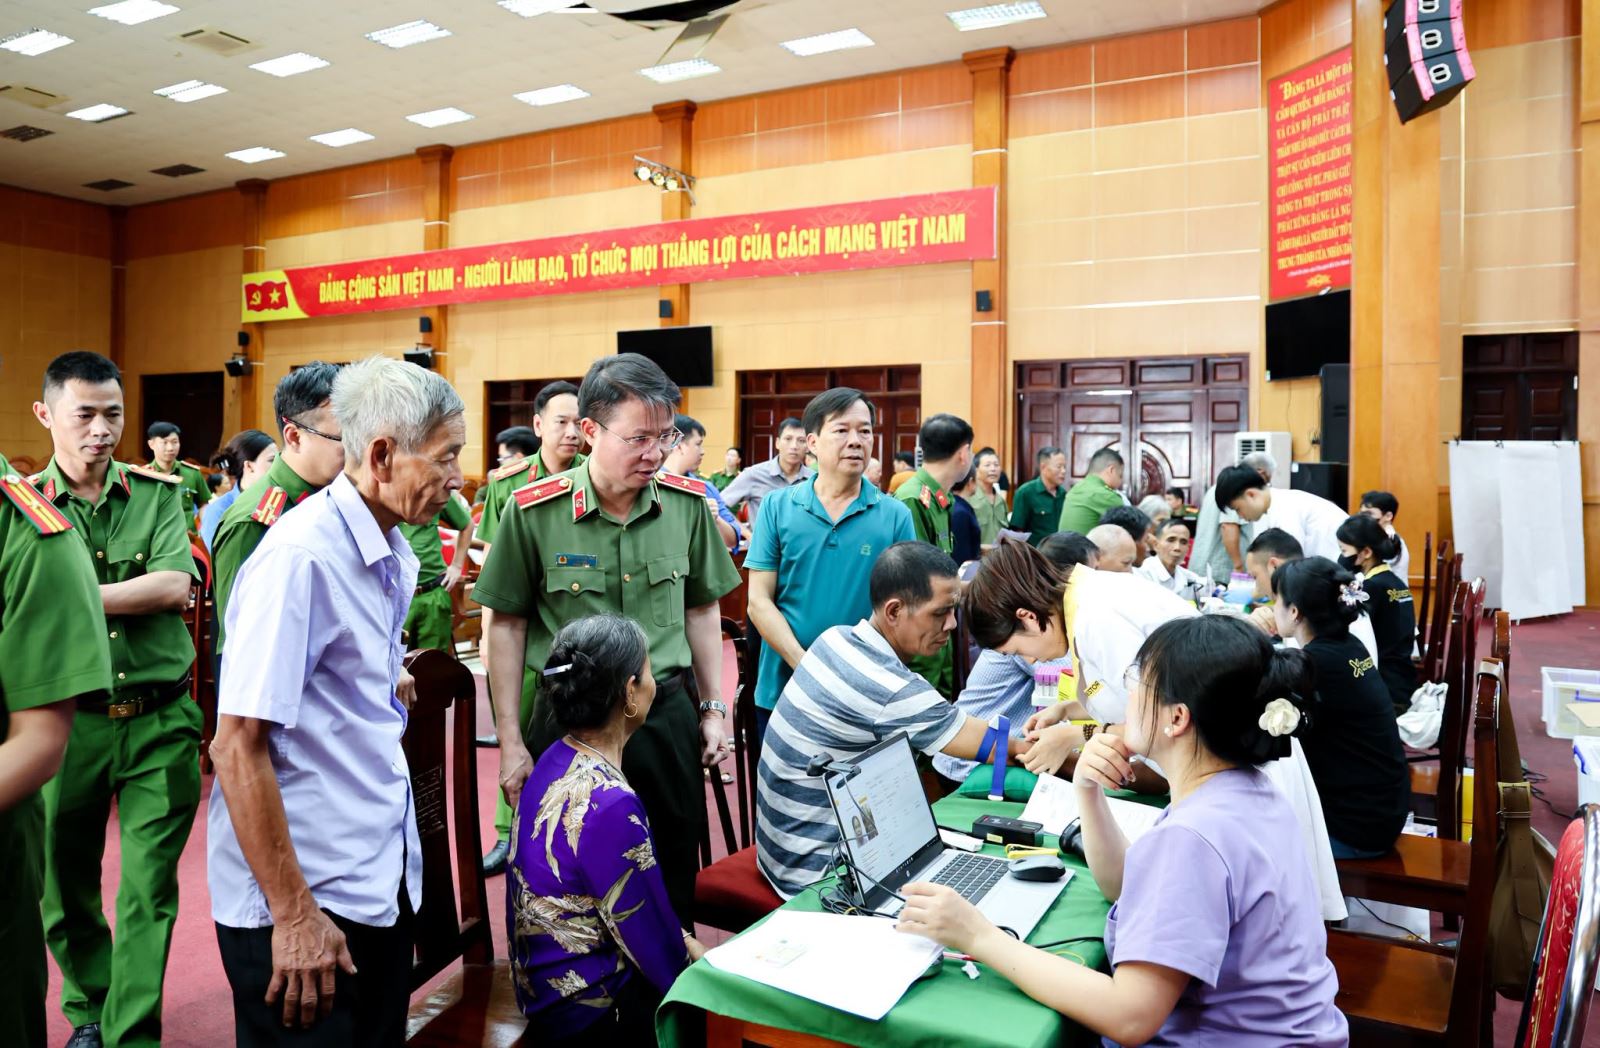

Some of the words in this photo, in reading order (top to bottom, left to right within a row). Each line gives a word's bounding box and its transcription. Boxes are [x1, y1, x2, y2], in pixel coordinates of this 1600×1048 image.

[320, 273, 346, 303] ĐẢNG
[348, 274, 376, 304] CỘNG
[378, 266, 400, 297] SẢN
[403, 268, 425, 297] VIỆT
[428, 267, 454, 292] NAM
[464, 258, 500, 288] NGƯỜI
[504, 256, 535, 284] LÃNH
[539, 255, 568, 285] ĐẠO,
[571, 243, 588, 277] TỔ
[591, 244, 627, 276] CHỨC
[630, 245, 657, 275] MỌI
[661, 233, 709, 268] THẮNG
[713, 235, 736, 269] LỢI
[741, 223, 772, 261] CỦA
[777, 225, 820, 259] CÁCH
[825, 223, 876, 258] MẠNG
[881, 214, 918, 252] VIỆT
[923, 213, 965, 245] NAM
